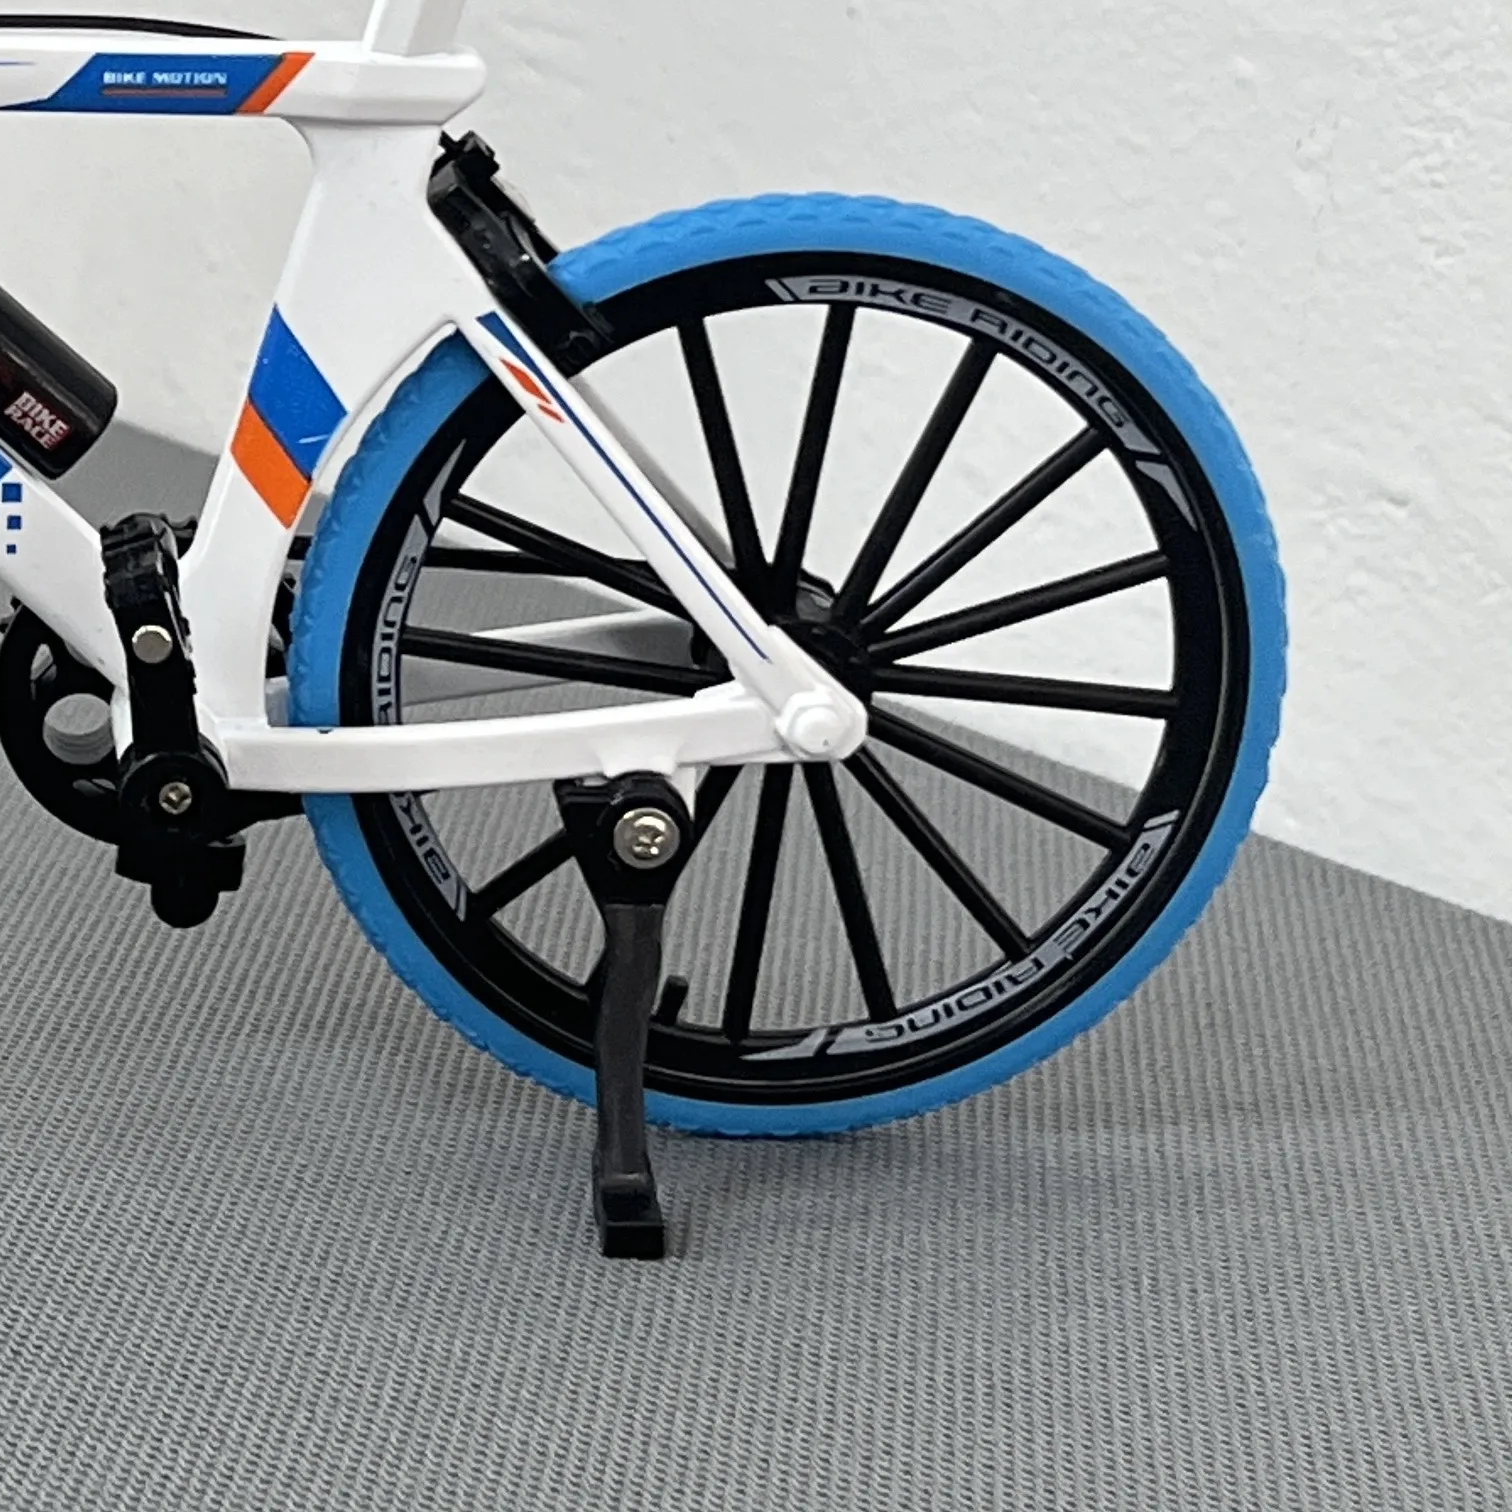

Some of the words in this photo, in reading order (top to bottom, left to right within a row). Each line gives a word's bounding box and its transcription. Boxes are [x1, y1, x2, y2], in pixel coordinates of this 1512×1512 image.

[103, 71, 146, 84] BIKE
[152, 71, 228, 84] MOTION
[807, 278, 953, 315] BIKE
[969, 306, 1133, 429] RIDING
[3, 404, 61, 450] RACE
[14, 391, 70, 437] BIKE
[392, 791, 452, 885] BIK
[1051, 842, 1156, 954] BIKE
[863, 956, 1045, 1044] RIDING
